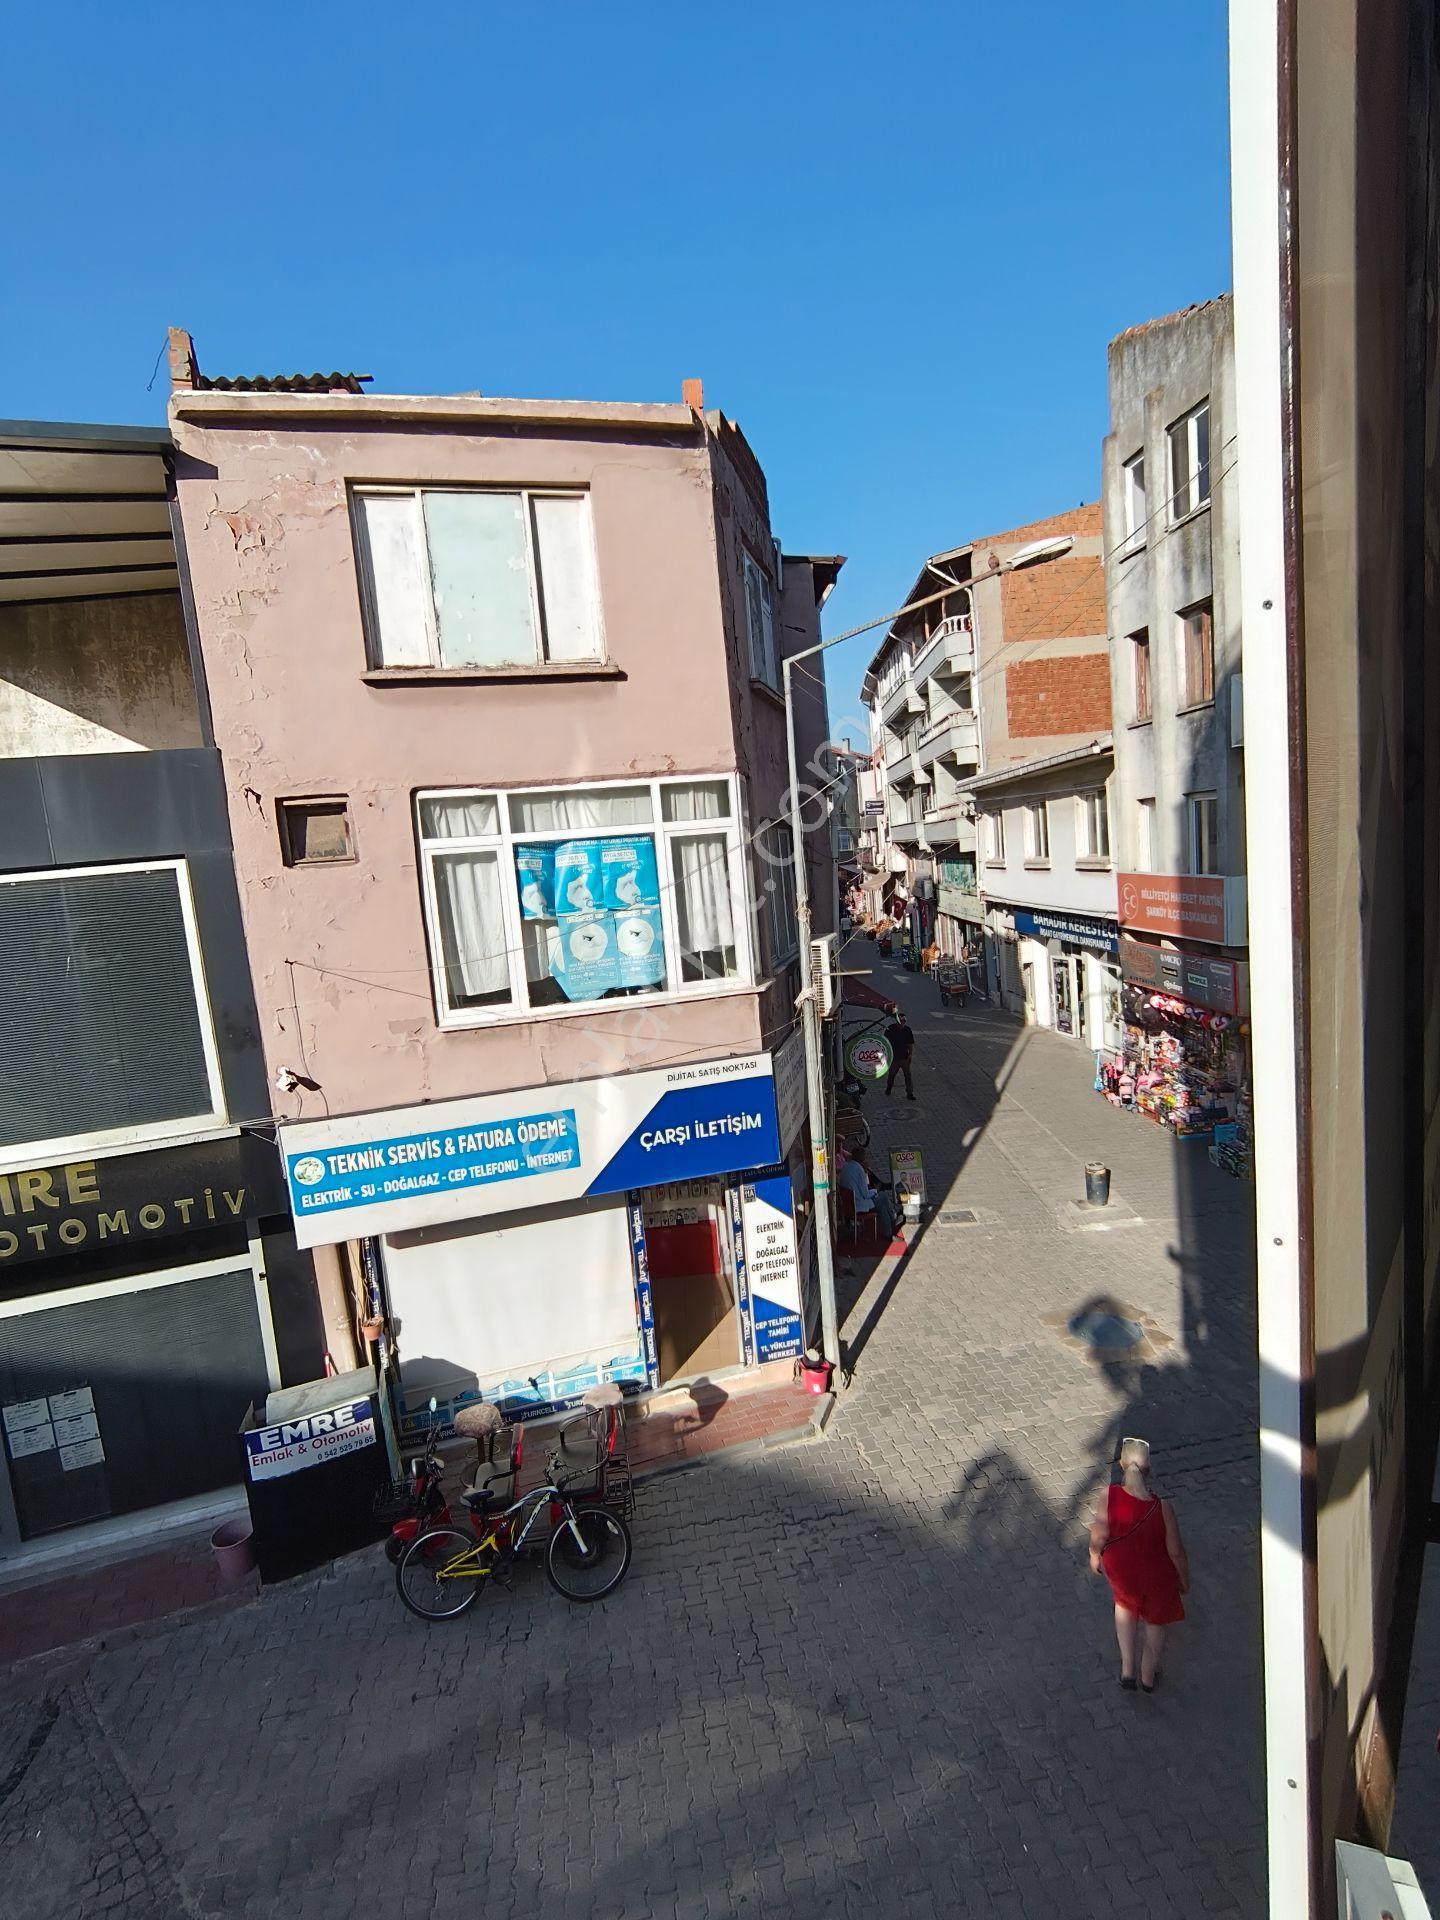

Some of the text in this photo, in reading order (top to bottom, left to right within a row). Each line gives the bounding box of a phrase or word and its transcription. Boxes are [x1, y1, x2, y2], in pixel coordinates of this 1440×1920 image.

[667, 1061, 757, 1082] DİJİTAL SATIŞ NOKTASI
[640, 1125, 690, 1152] ÇARŞI
[695, 1112, 762, 1139] İLETİŞİM
[327, 1118, 568, 1175] TEKNİK SERVİS & FATURA ÖDEME
[301, 1186, 352, 1208] ELEKTRİK
[361, 1183, 376, 1198] SU
[383, 1172, 440, 1194] DOĞALGAZ
[447, 1167, 467, 1182] CEP
[469, 1159, 519, 1179] TELEFONU
[526, 1147, 573, 1168] İNTERNET
[0, 1161, 101, 1216] RE
[0, 1187, 246, 1257] OTOMOTİV
[756, 1220, 785, 1234] ELEKTRİK
[767, 1235, 776, 1244] SU
[756, 1244, 789, 1259] DOĞALGAZ
[752, 1256, 795, 1272] CEP TELEFONU
[760, 1270, 789, 1284] İNTERNET
[755, 1314, 800, 1330] CEP TELEFONU
[767, 1325, 790, 1337] TAMİRİ
[760, 1338, 800, 1353] TL YÜKLEME
[767, 1348, 796, 1361] MERKEZİ
[260, 1404, 357, 1451] EMRE
[252, 1421, 371, 1468] Emlak & Otomotiv
[324, 1449, 338, 1460] 542
